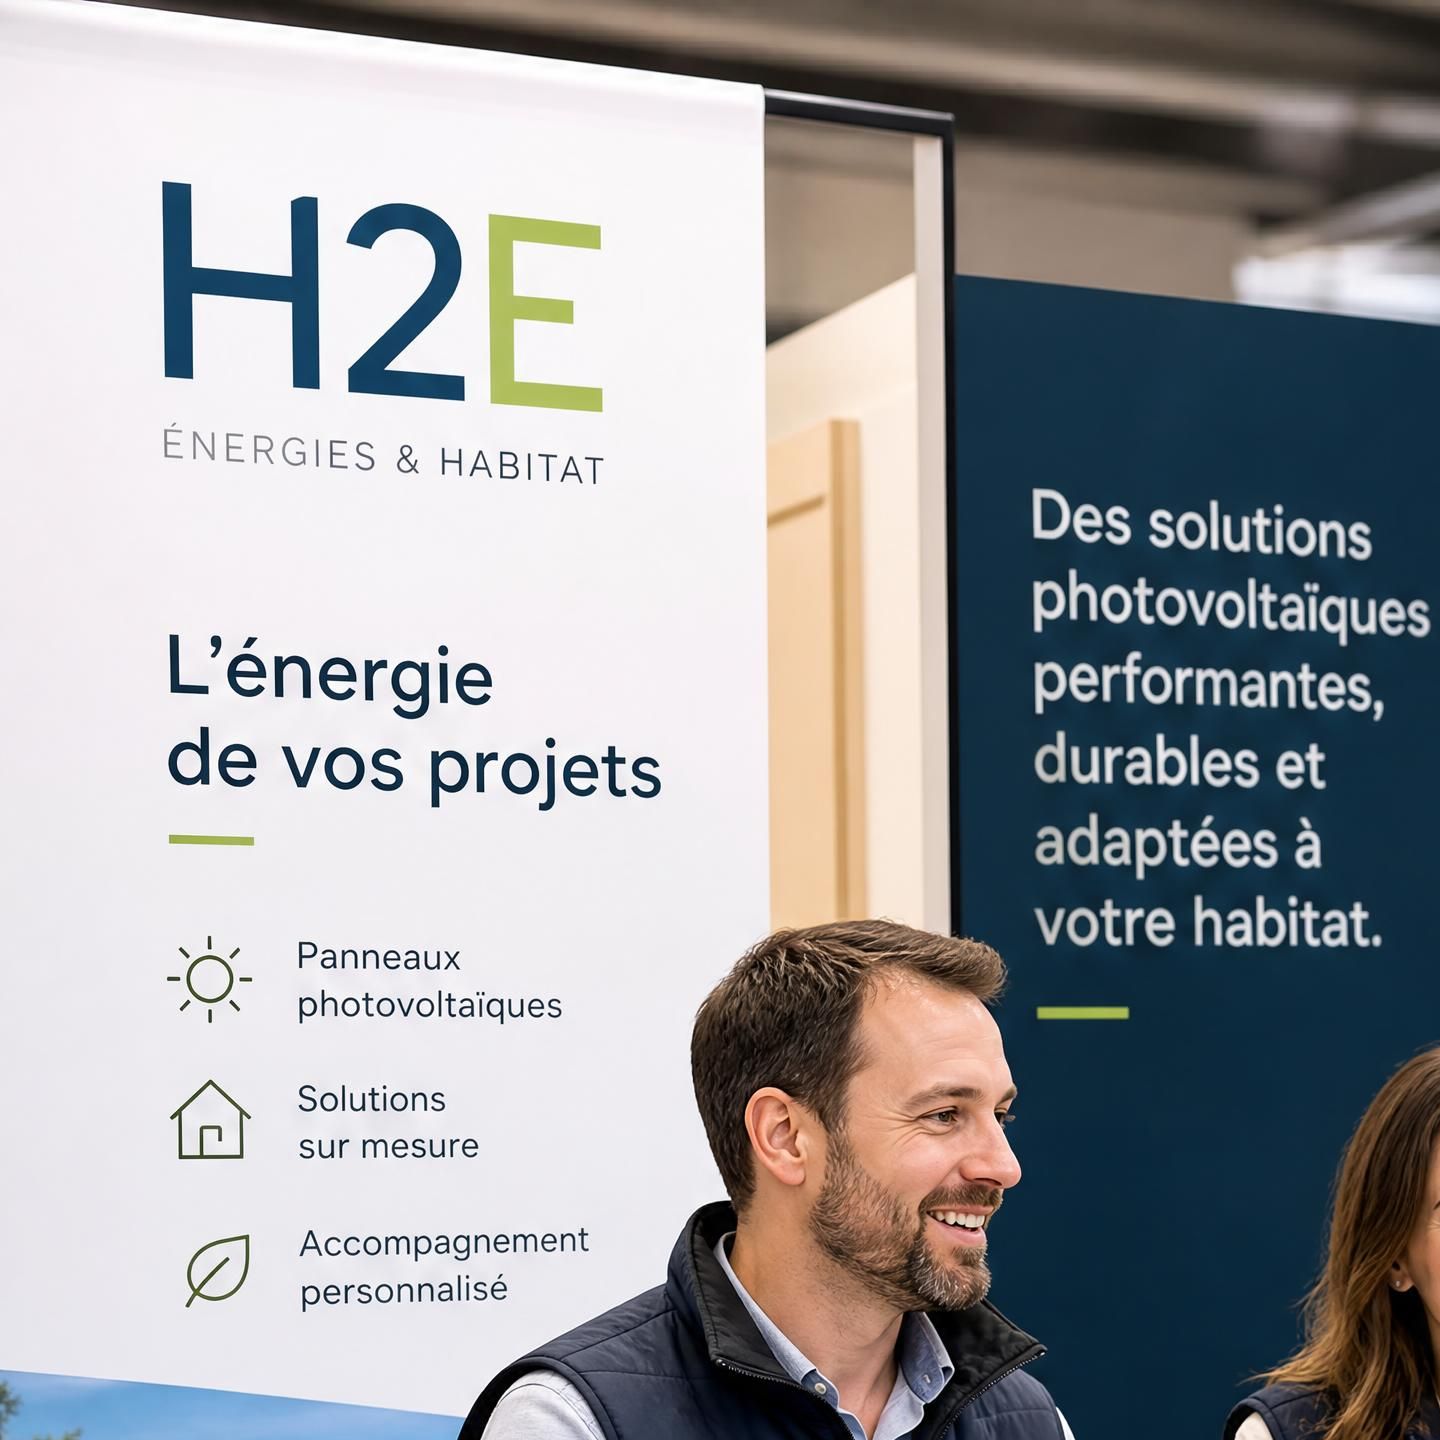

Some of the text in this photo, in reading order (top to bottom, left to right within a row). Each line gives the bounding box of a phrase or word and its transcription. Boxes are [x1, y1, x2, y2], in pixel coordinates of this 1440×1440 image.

[162, 181, 603, 412] H2E
[162, 422, 605, 485] ÉNERGIES & HABITAT
[1032, 488, 1373, 561] Des solutions
[1032, 568, 1432, 646] photovoltaïques
[1034, 651, 1385, 722] performantes,
[168, 726, 662, 812] de vos projets
[1034, 731, 1327, 790] durables et
[1035, 813, 1322, 881] adaptées à
[1034, 895, 1383, 948] votre habitat.
[297, 941, 461, 971] Panneaux
[298, 989, 563, 1025] photovoltaïques
[298, 1084, 446, 1113] Solutions
[298, 1136, 479, 1160] sur mesure
[299, 1227, 590, 1263] Accompagnement
[301, 1273, 508, 1313] personnalisé
